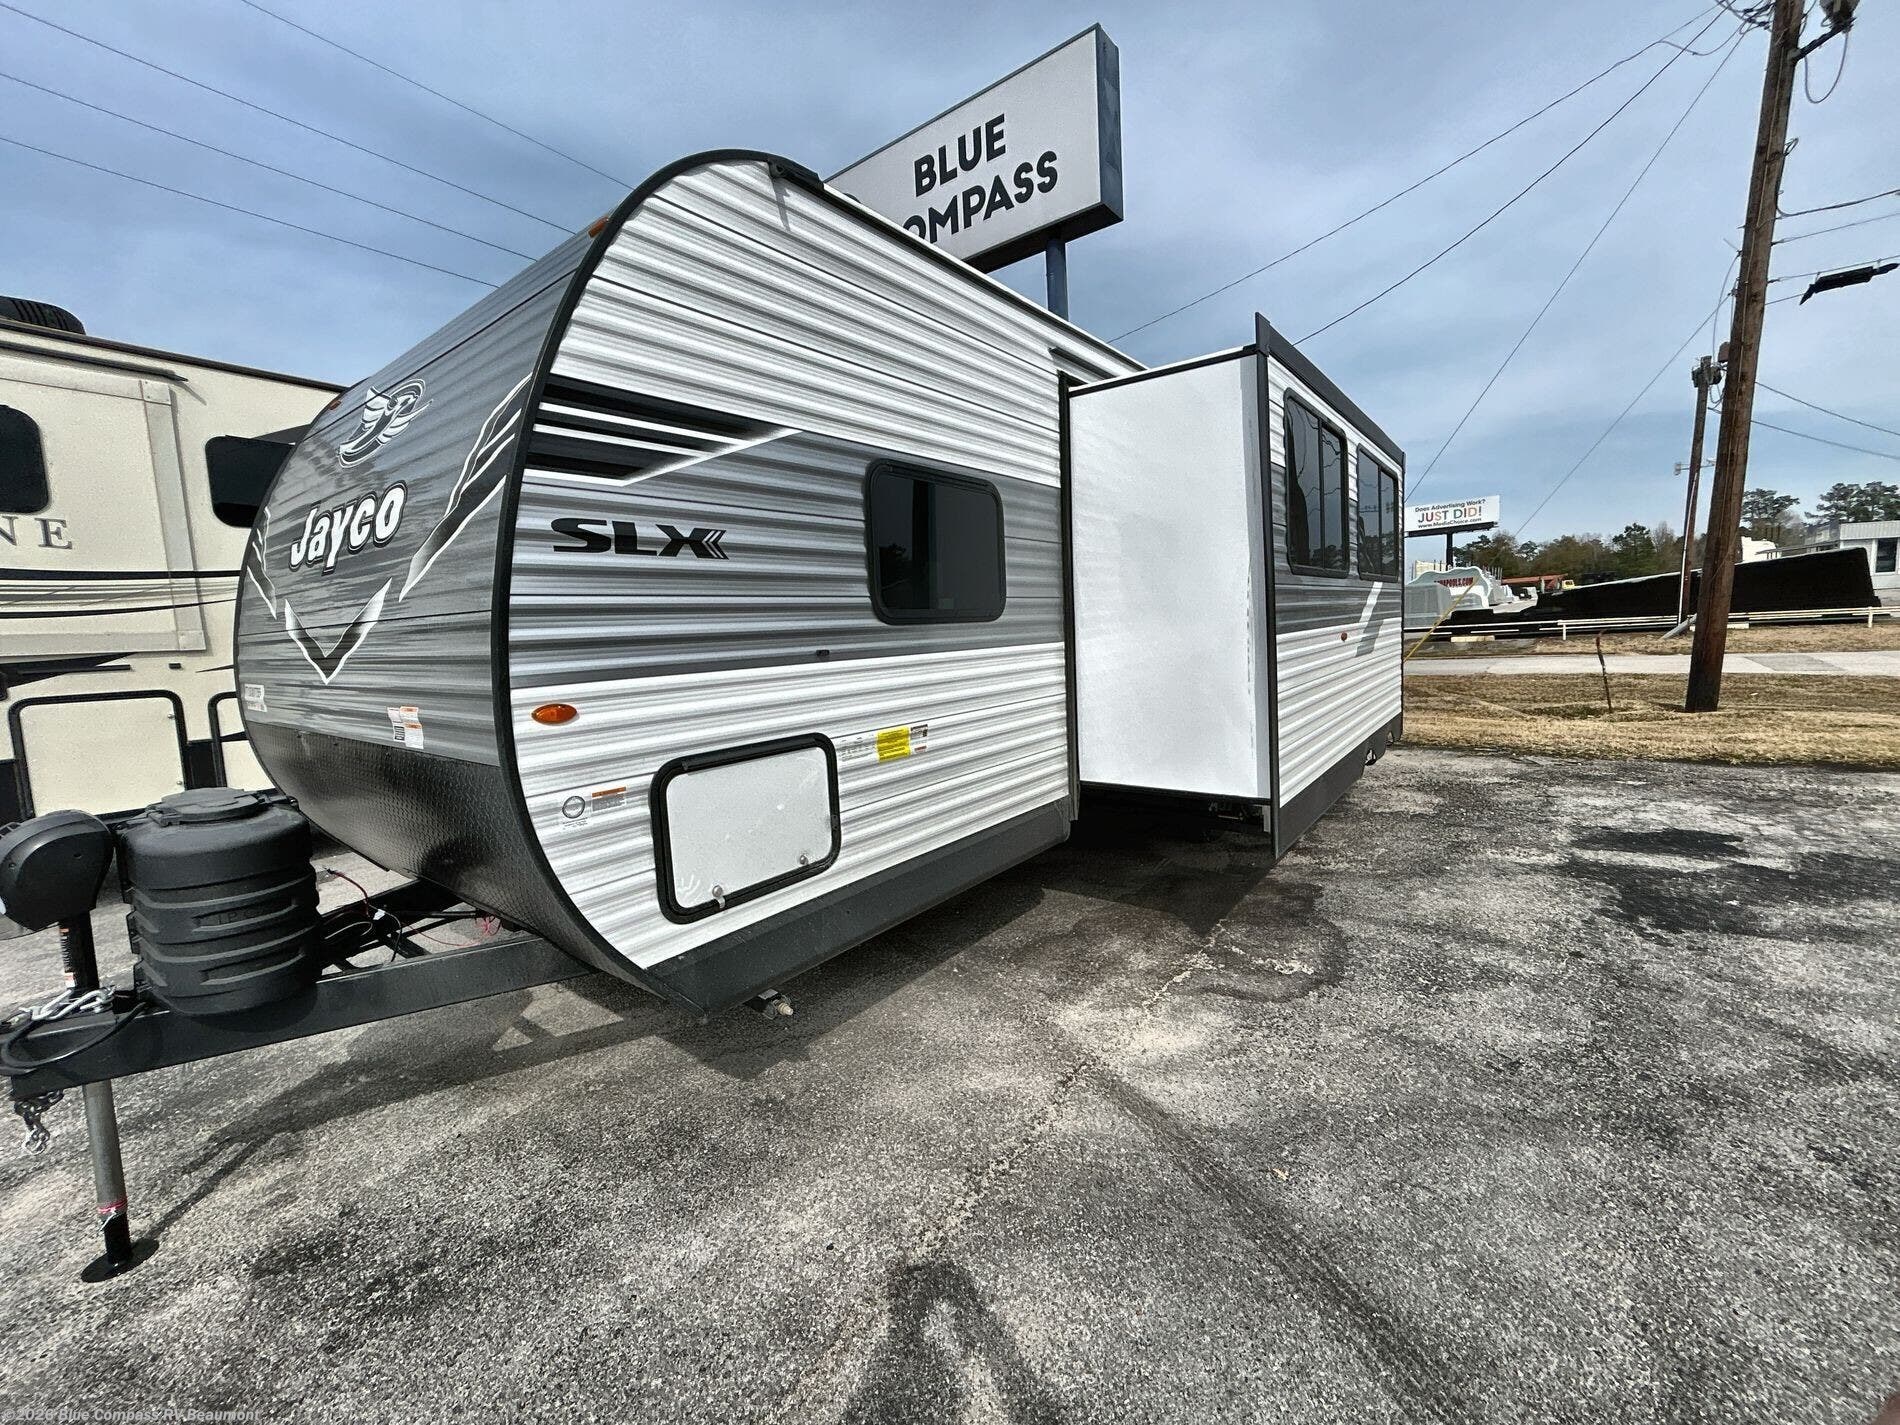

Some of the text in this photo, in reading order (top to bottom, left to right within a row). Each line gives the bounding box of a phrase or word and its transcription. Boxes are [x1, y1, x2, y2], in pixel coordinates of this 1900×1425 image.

[914, 113, 1006, 197] BLUE
[903, 150, 1058, 244] OMPASS
[289, 481, 408, 575] Jayco
[1418, 505, 1482, 523] JUST DID!
[1431, 502, 1466, 510] Advertising
[551, 517, 729, 560] SLX
